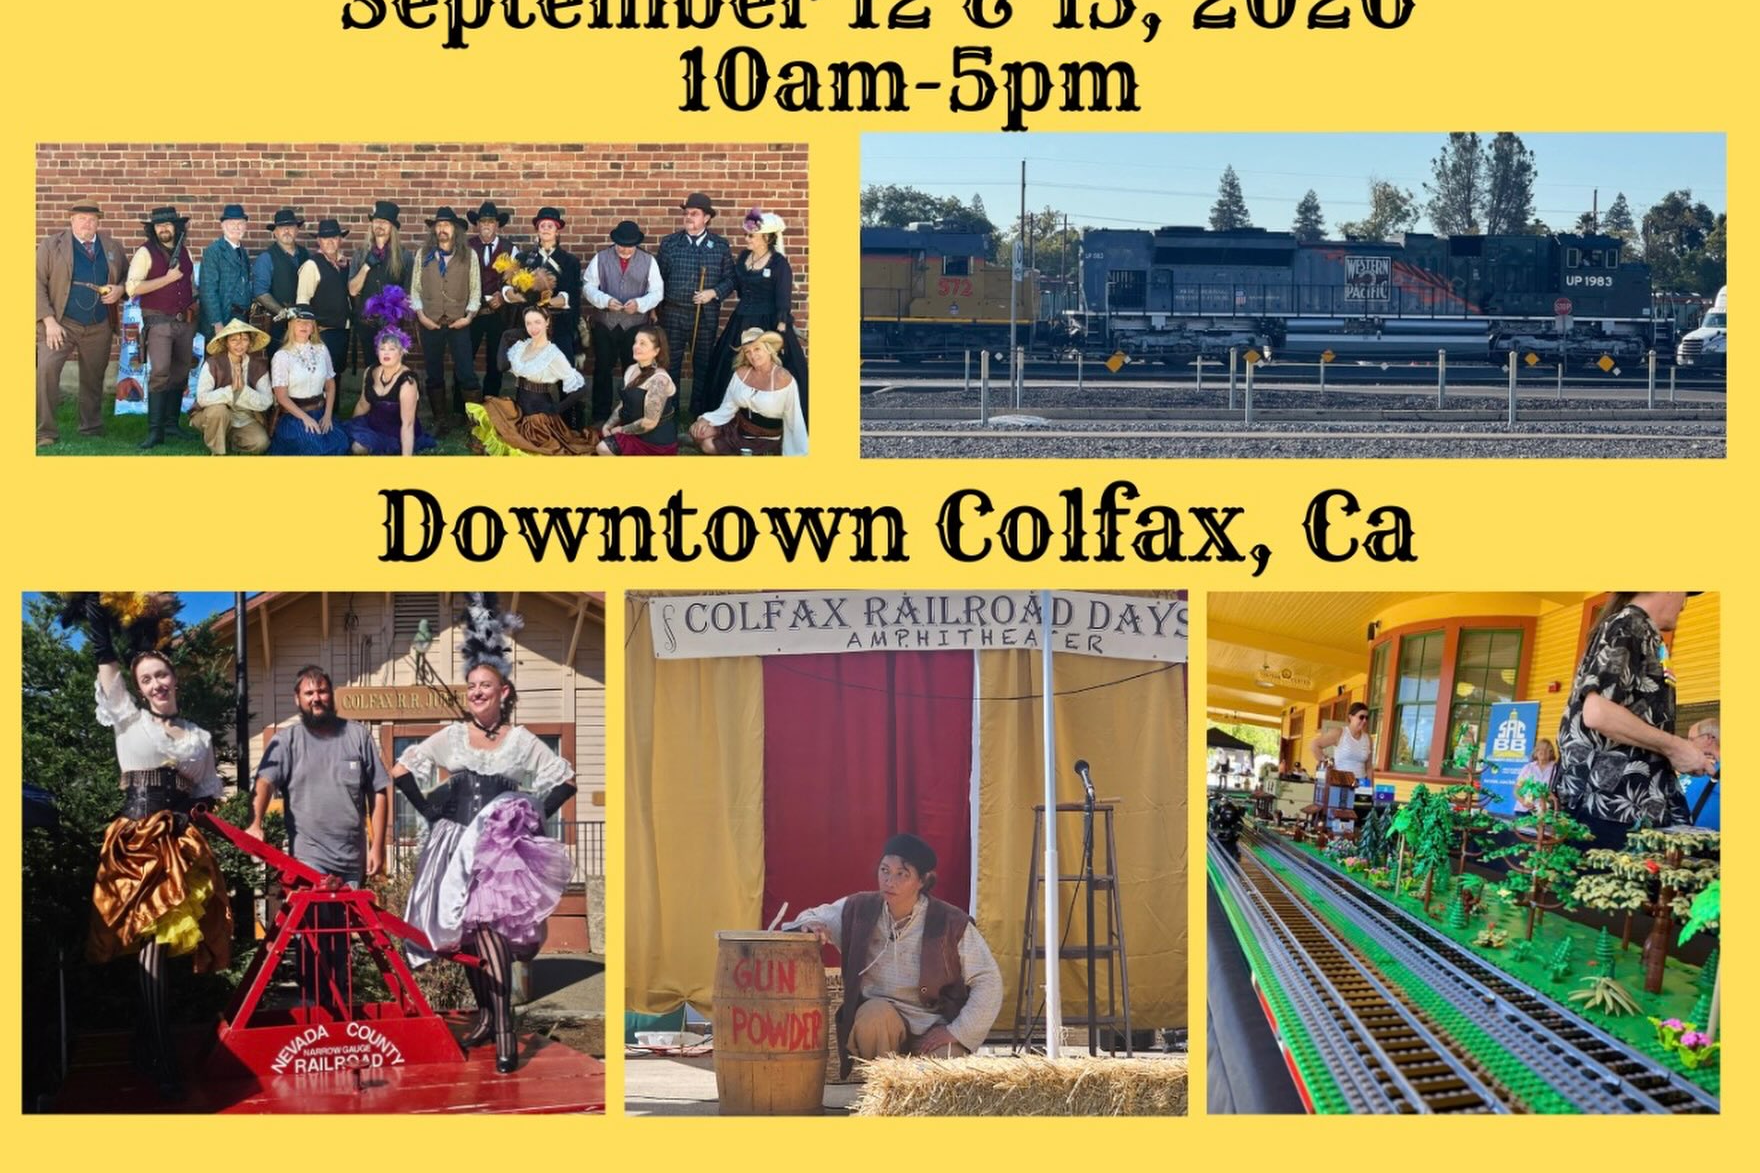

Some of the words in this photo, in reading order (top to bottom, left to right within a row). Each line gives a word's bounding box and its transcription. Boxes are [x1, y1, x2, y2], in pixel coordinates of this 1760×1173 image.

[678, 45, 1142, 132] 10am-5pm
[1346, 257, 1389, 276] WESTERN
[1345, 284, 1389, 300] PACIFIC
[1566, 276, 1583, 286] UP
[1584, 275, 1613, 287] 1983
[377, 488, 910, 563] Downtown
[935, 480, 1273, 578] Colfax,
[1301, 488, 1419, 563] Ca
[685, 596, 852, 633] COLFAX
[863, 594, 1074, 629] RAILROAD
[1086, 600, 1188, 639] DAYS
[846, 628, 1104, 654] AMPHITHEAER
[342, 692, 394, 710] COLFAX
[1493, 737, 1527, 751] BB
[732, 957, 796, 994] GUN
[731, 1005, 823, 1052] POWDER
[271, 1024, 330, 1074] NEVADA
[346, 1022, 405, 1066] COUNTY
[303, 1046, 342, 1056] NARROW
[343, 1044, 371, 1054] GAUGE
